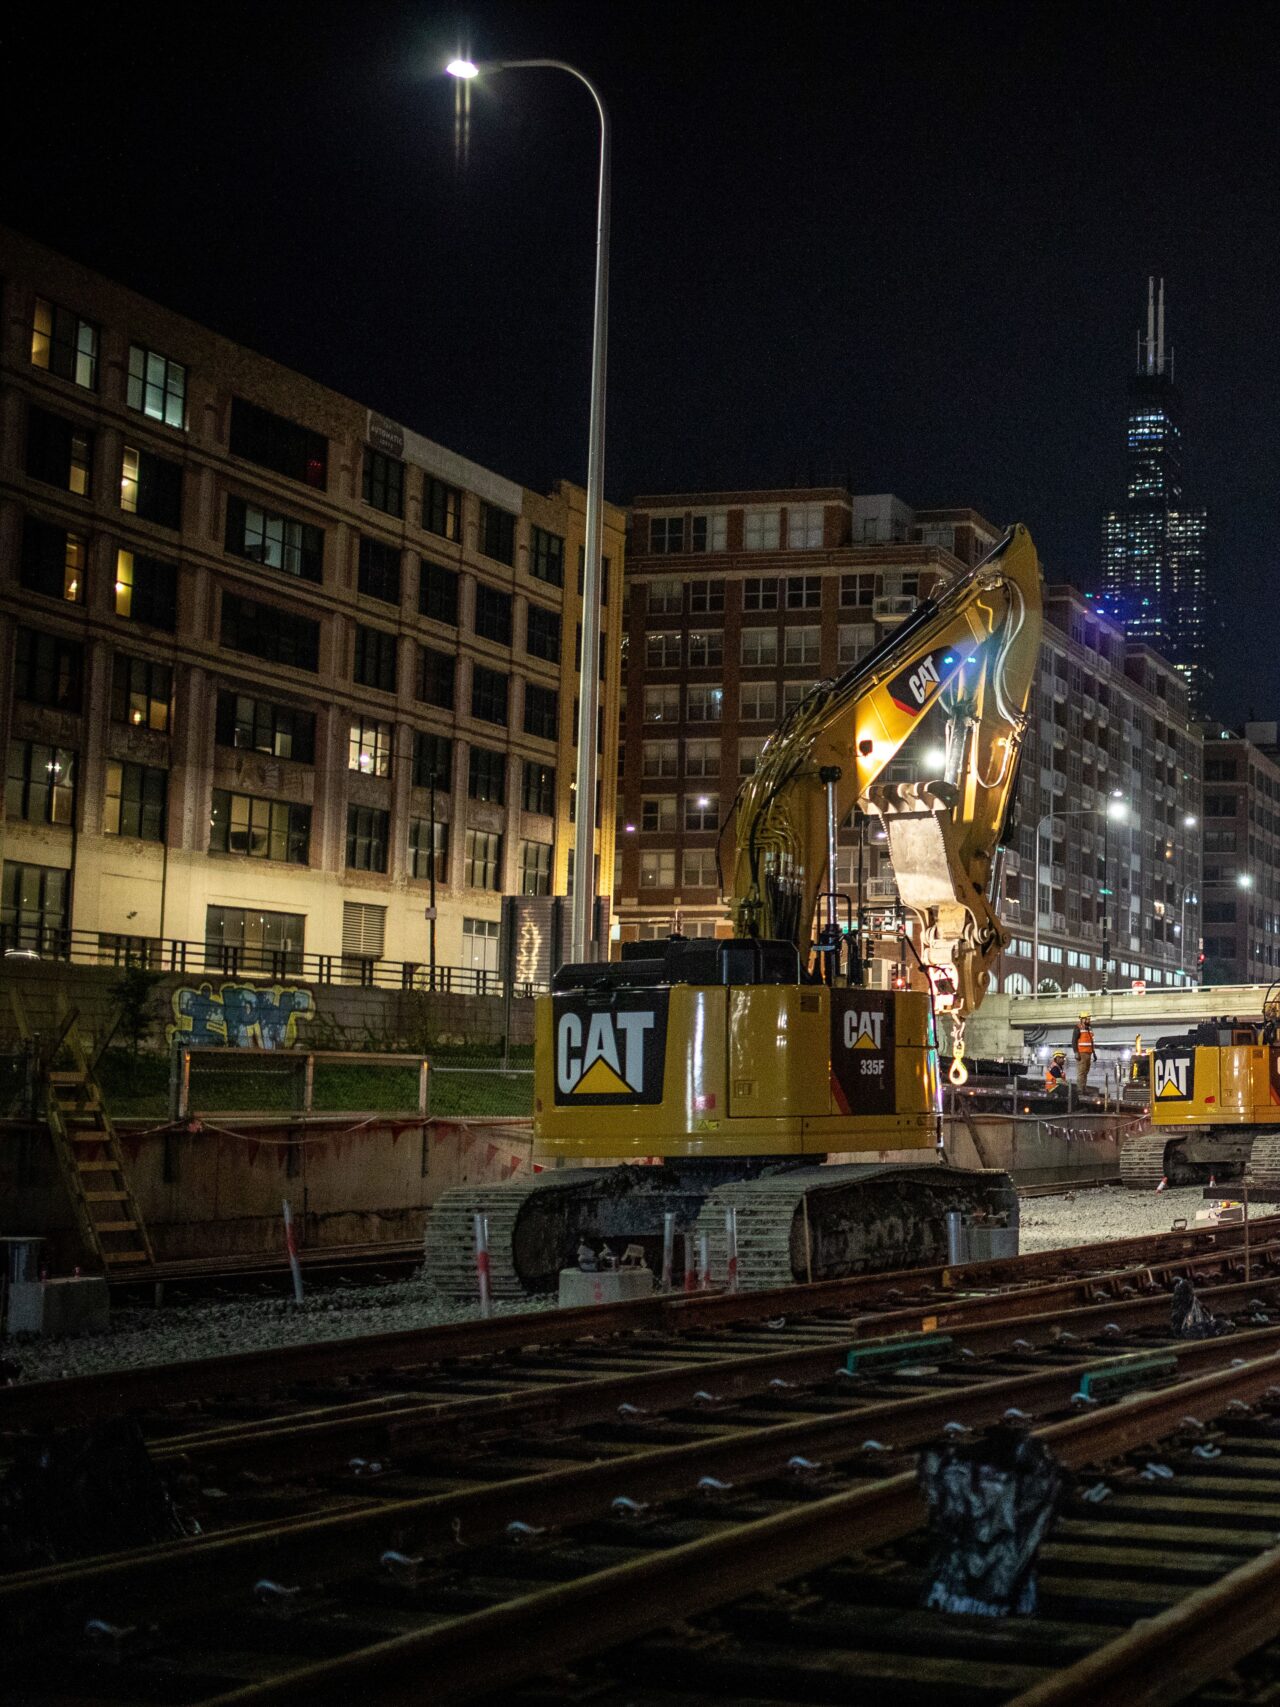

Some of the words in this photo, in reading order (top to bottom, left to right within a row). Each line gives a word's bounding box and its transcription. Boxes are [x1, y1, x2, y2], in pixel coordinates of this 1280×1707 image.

[909, 655, 941, 704] CAT
[844, 1010, 884, 1050] CAT
[558, 1011, 655, 1094] CAT
[860, 1060, 884, 1075] 335F
[1154, 1058, 1190, 1097] CAT
